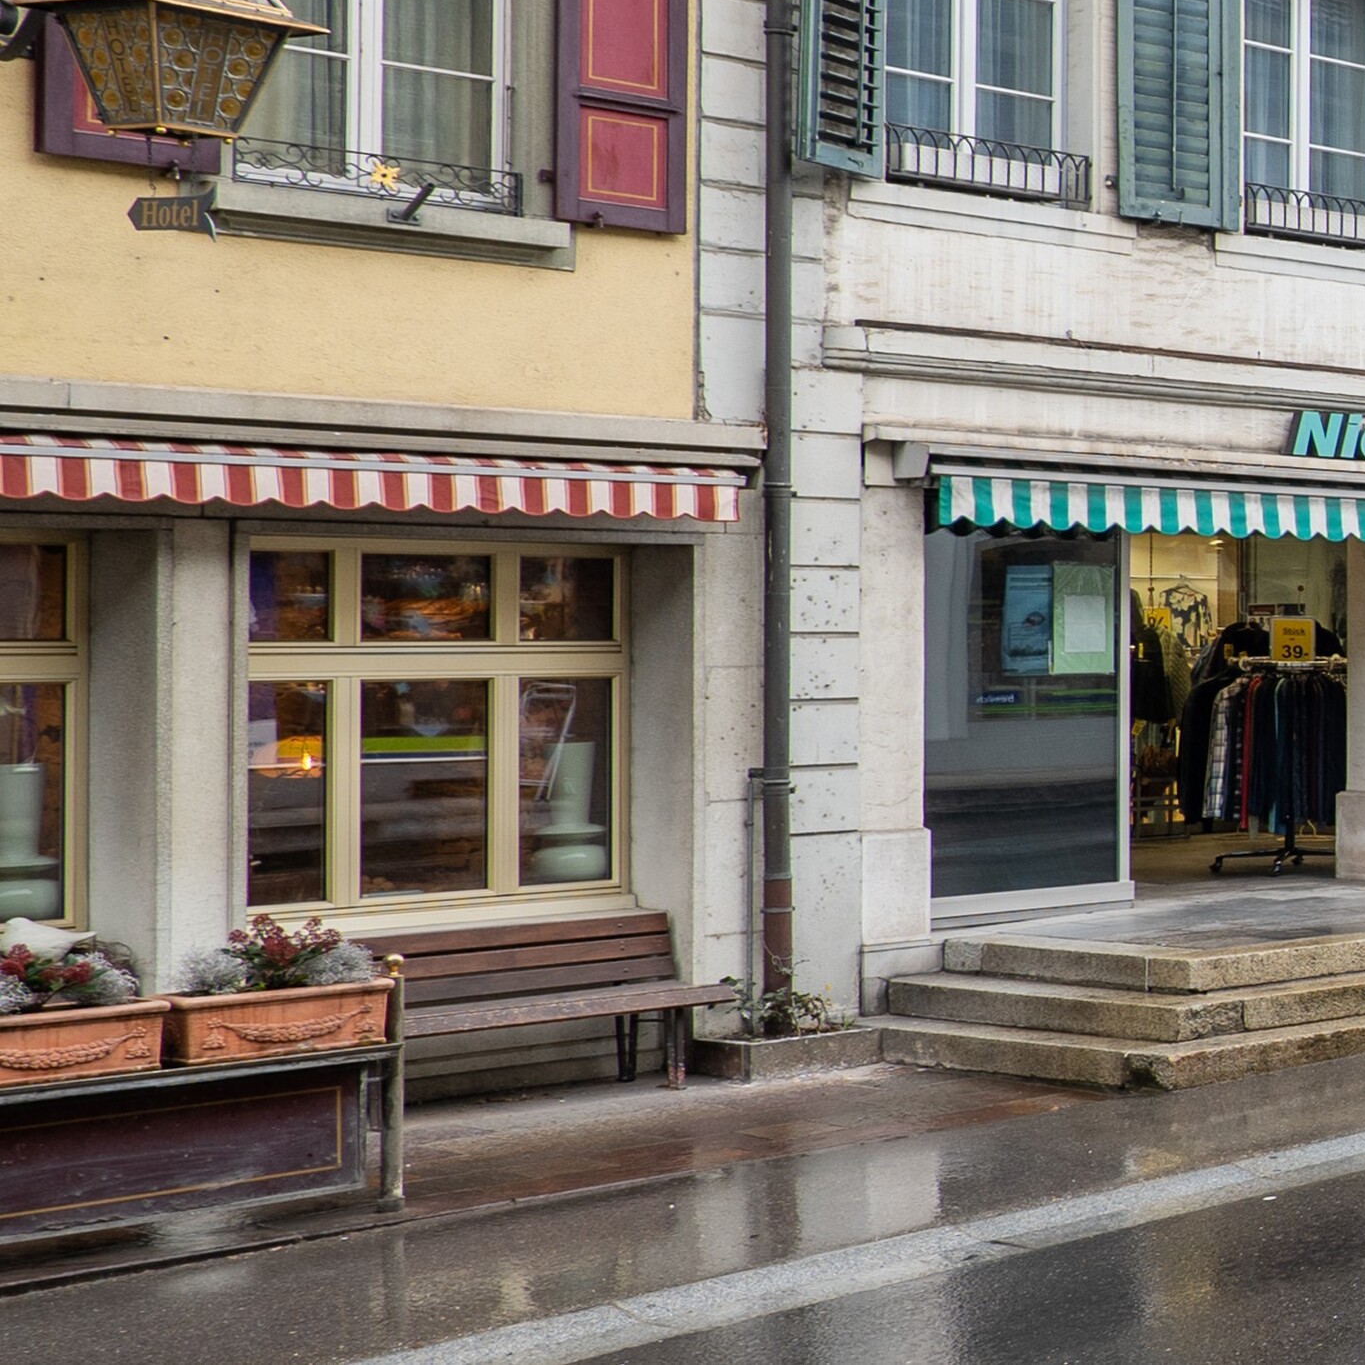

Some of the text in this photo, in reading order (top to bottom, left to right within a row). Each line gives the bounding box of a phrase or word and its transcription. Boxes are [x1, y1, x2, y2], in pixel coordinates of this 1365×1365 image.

[105, 19, 141, 112] HOTEL
[141, 200, 199, 227] Hotel
[1282, 627, 1306, 636] Stück
[1282, 645, 1309, 659] 39-
